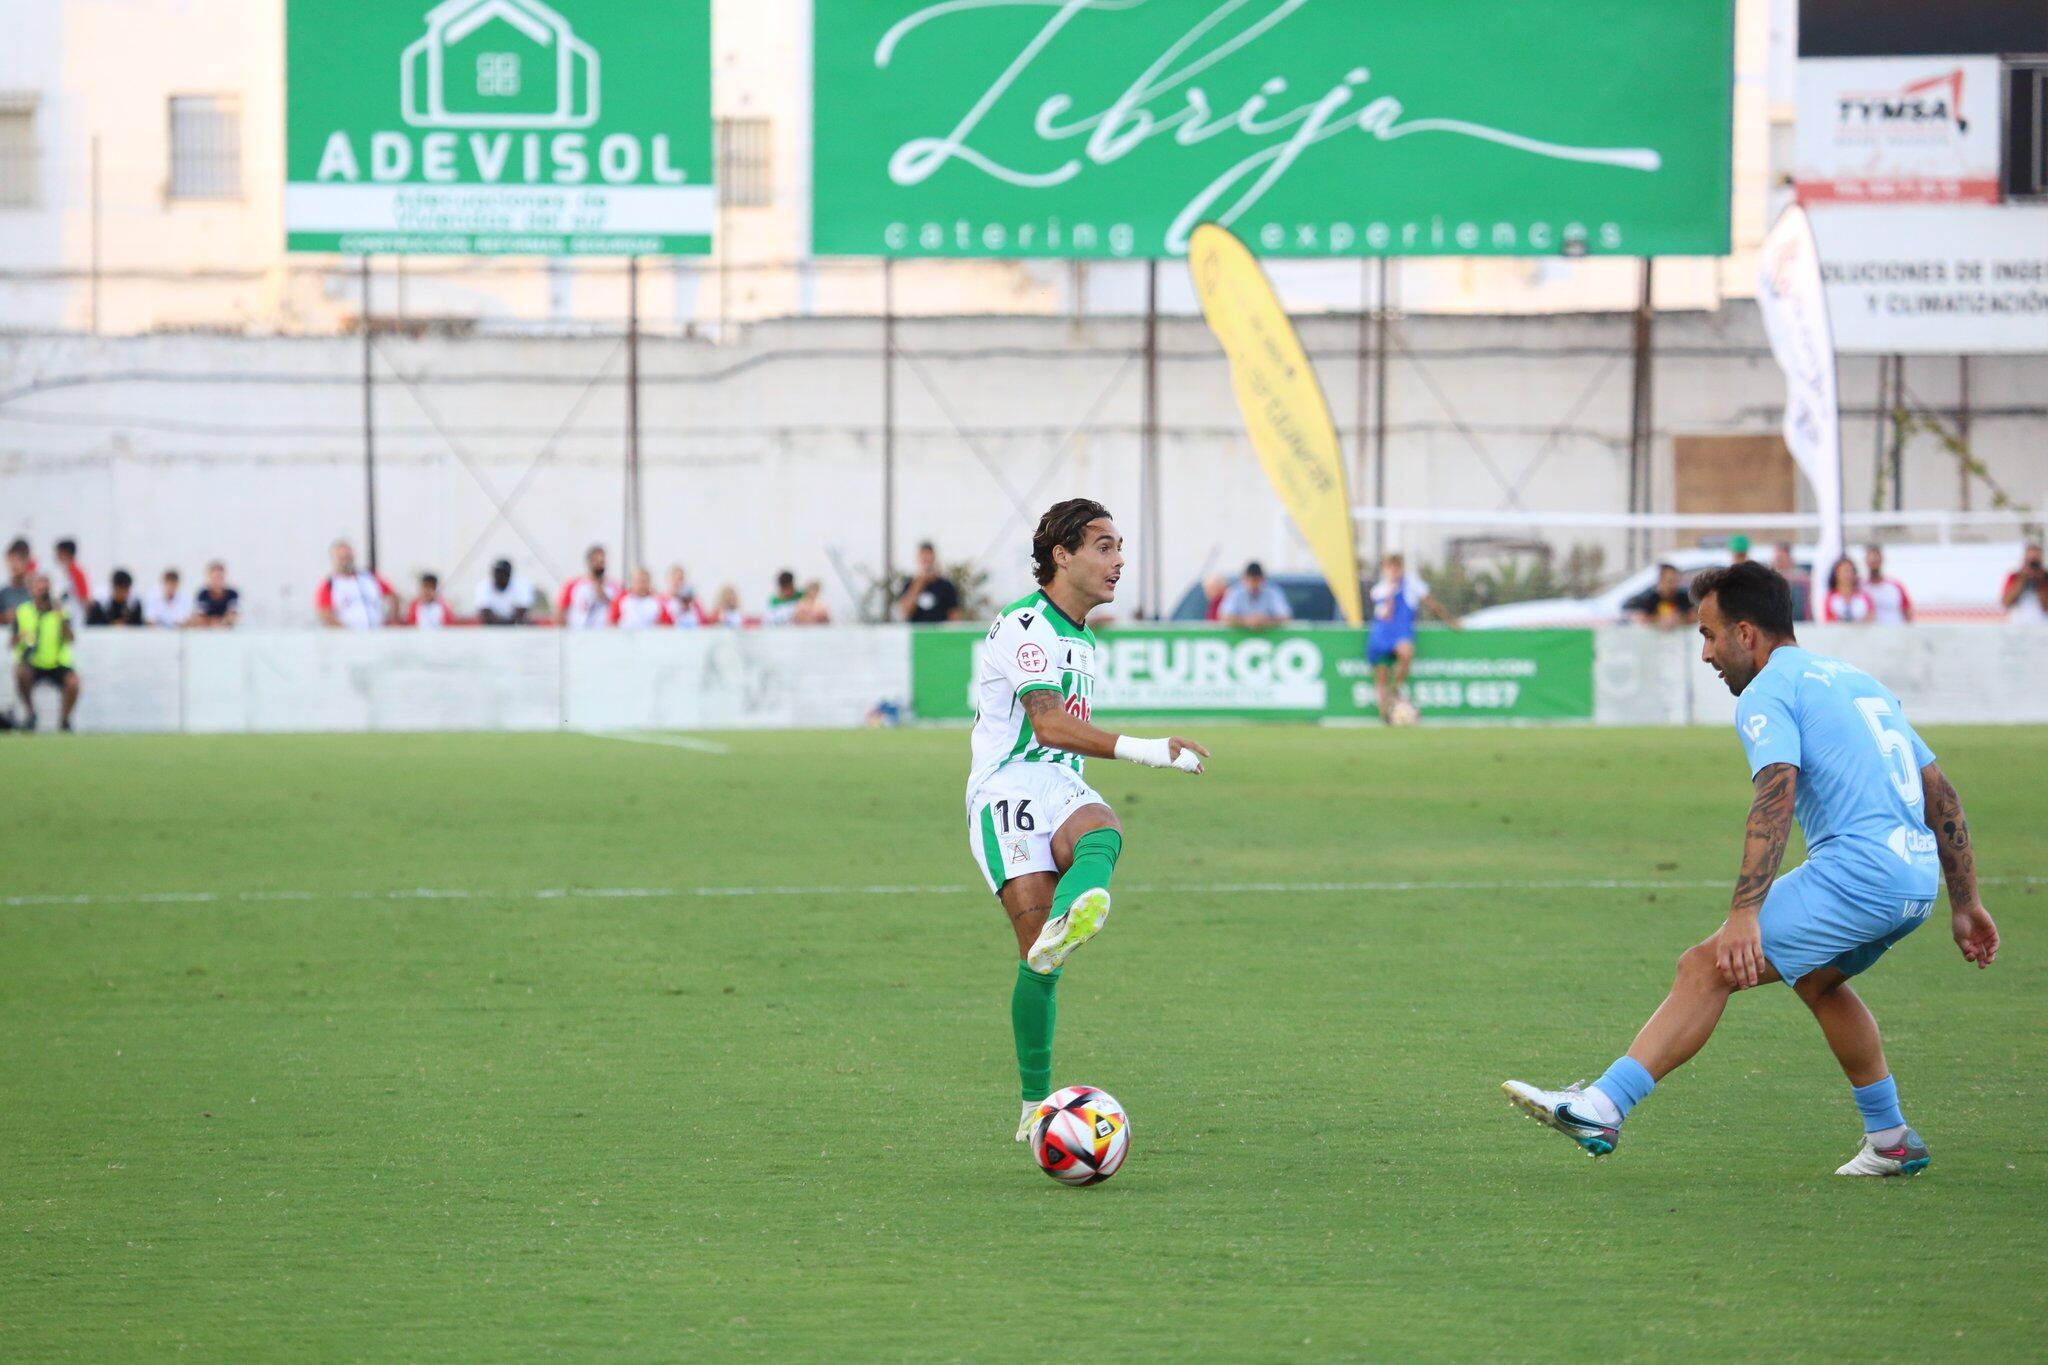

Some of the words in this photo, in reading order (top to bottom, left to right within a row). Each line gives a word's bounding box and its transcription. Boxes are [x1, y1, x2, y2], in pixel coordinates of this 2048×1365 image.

[1838, 99, 1948, 121] TYMSA
[316, 130, 688, 184] ADEVISOL
[884, 215, 1136, 258] catering
[1259, 215, 1624, 254] experiences
[1821, 262, 1946, 283] OLUCIONES
[1955, 261, 1983, 281] DE
[1995, 261, 2048, 281] INGE
[1853, 697, 1922, 806] 5
[993, 799, 1035, 834] 16
